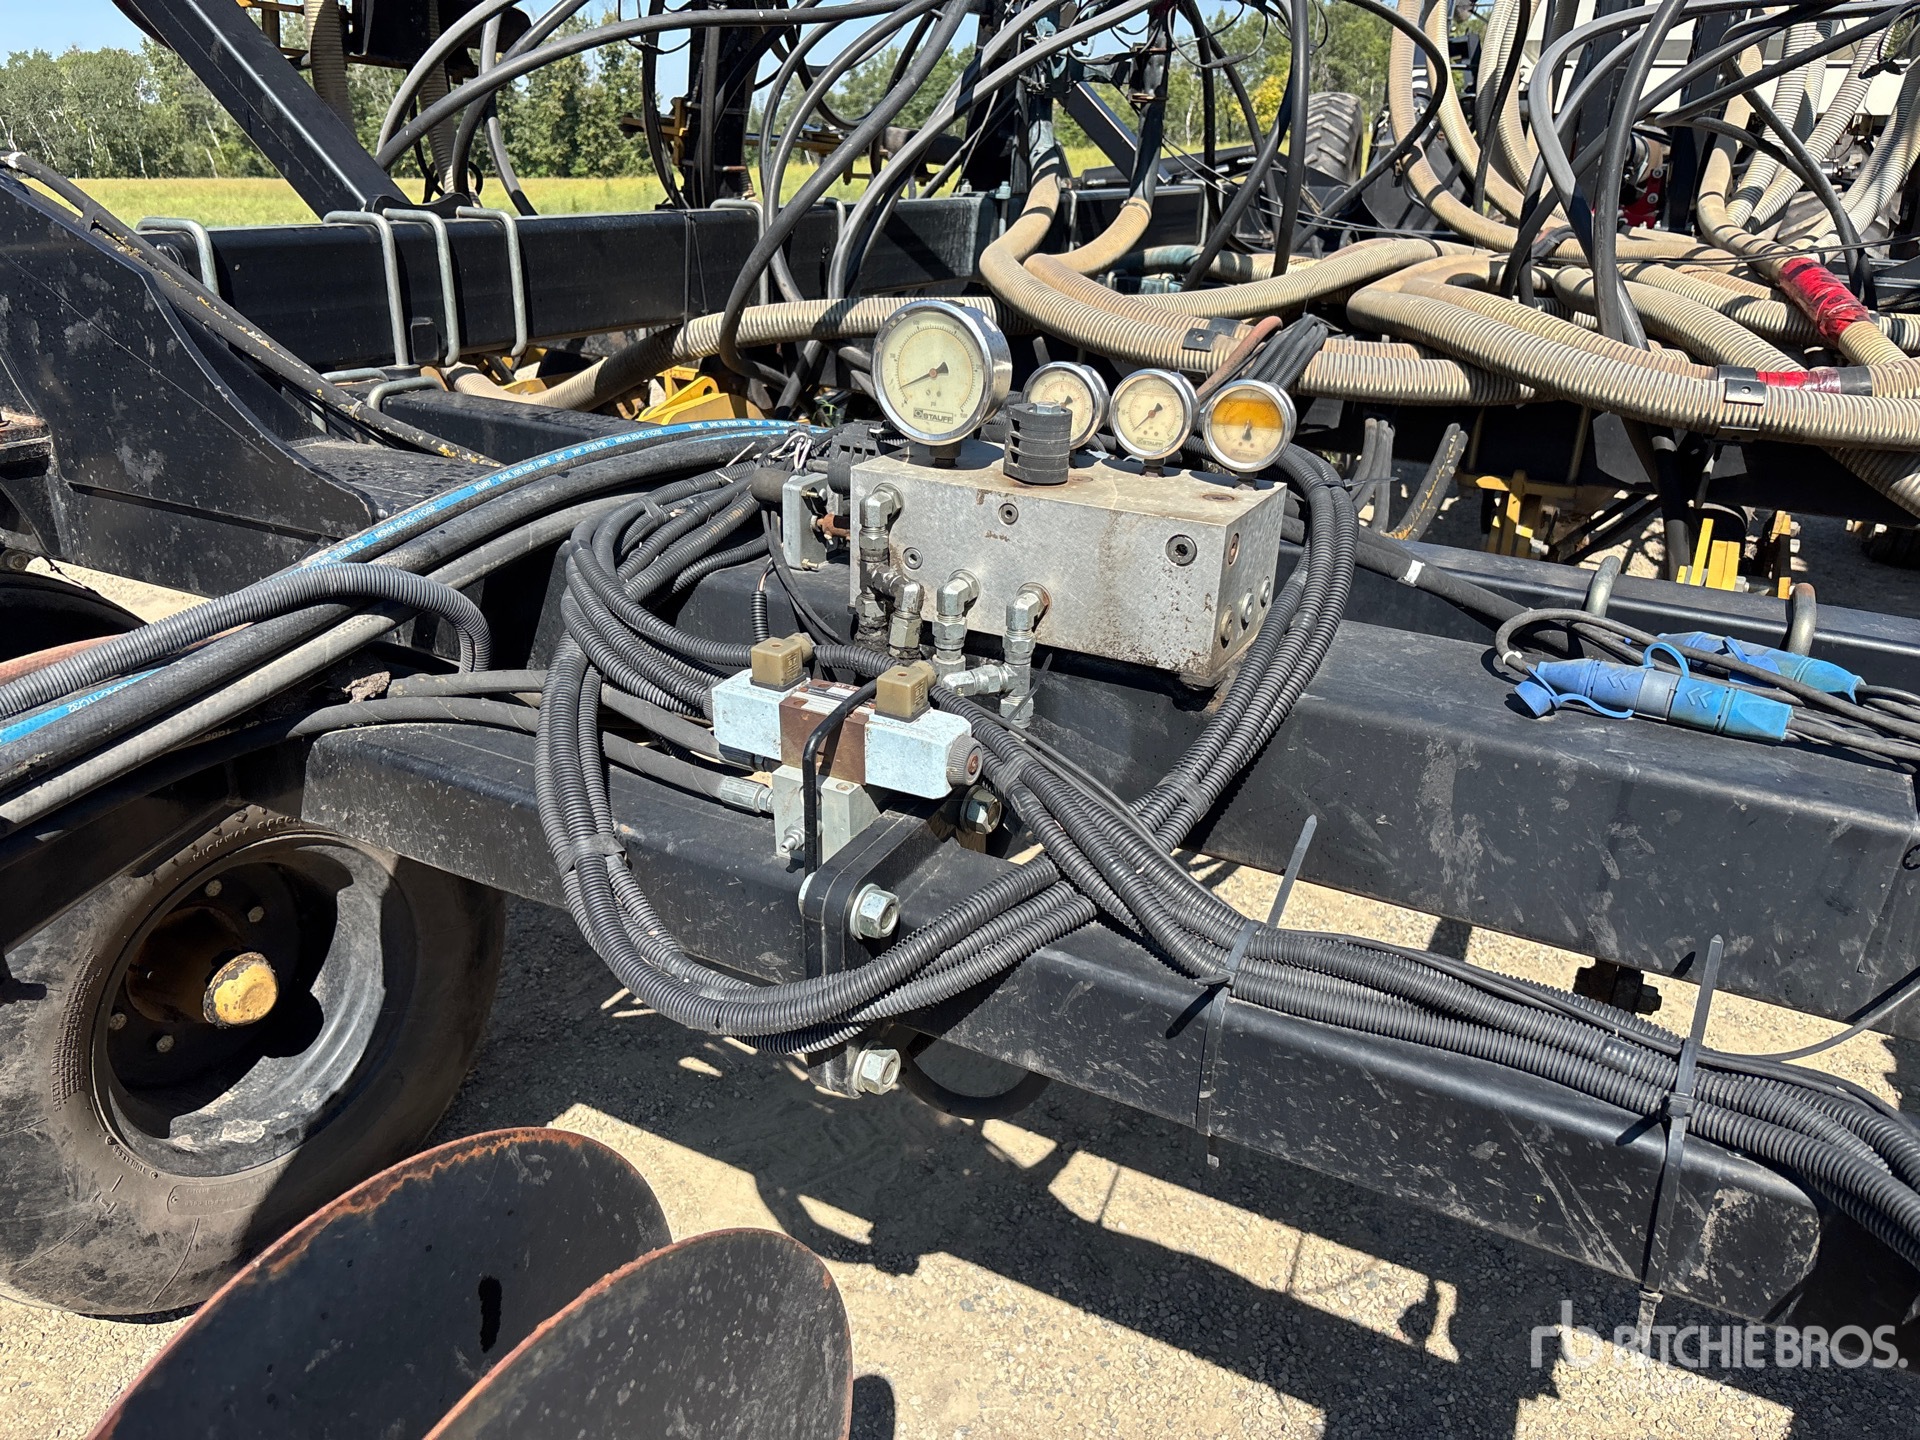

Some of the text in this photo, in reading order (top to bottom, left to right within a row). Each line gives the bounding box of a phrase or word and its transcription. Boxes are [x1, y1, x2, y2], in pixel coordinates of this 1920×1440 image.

[923, 412, 953, 423] STAUFF
[335, 545, 352, 560] 3120
[351, 540, 365, 552] PSI
[374, 525, 397, 539] MSHA
[473, 479, 493, 491] KURT
[51, 1081, 62, 1113] SAFETY
[112, 1145, 147, 1175] TUBELESS
